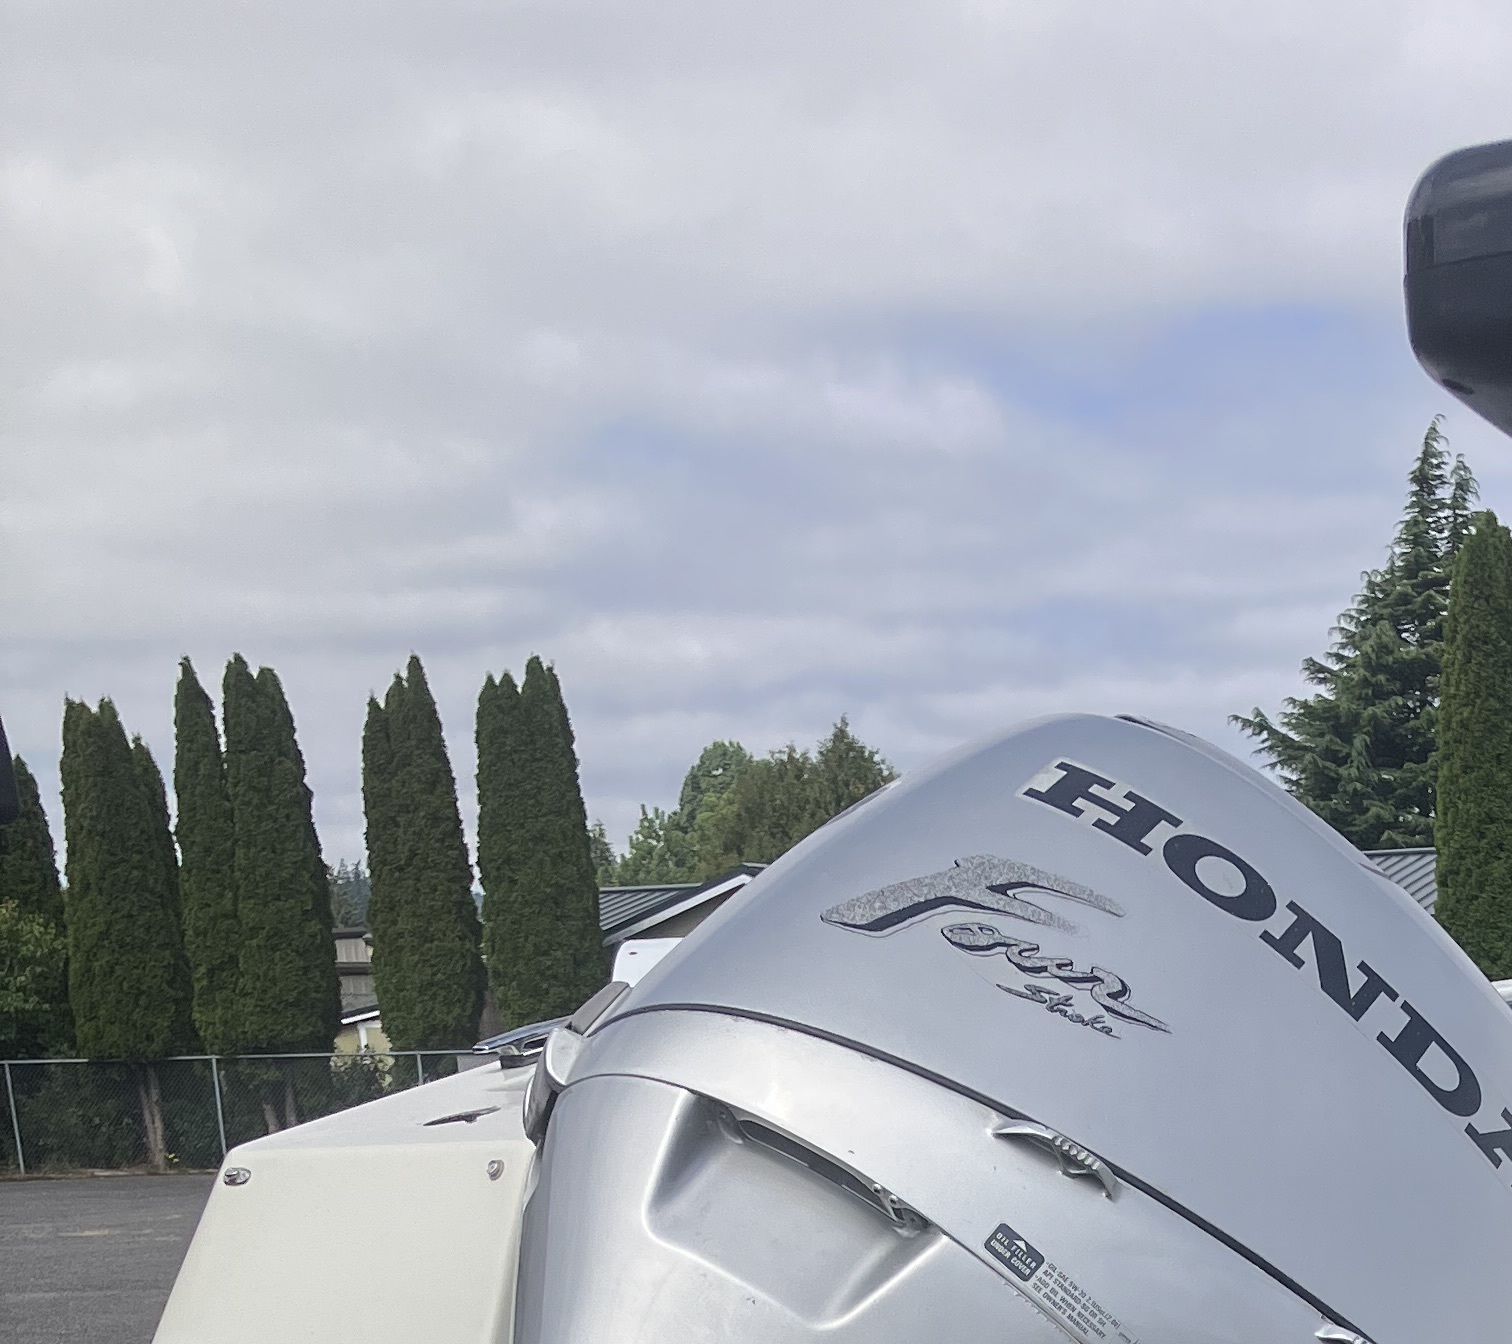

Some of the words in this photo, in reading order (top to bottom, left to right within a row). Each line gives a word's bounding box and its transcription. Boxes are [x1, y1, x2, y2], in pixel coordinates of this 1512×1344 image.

[996, 983, 1121, 1039] Stroke
[989, 1238, 1012, 1259] UNDER
[1009, 1255, 1032, 1276] COVER
[994, 1231, 1011, 1246] OIL
[1009, 1244, 1037, 1269] FILLER
[1030, 1281, 1043, 1294] SEE
[1040, 1291, 1068, 1316] OWNER'S
[1035, 1276, 1050, 1289] ADD
[1048, 1286, 1059, 1297] OIL
[1057, 1295, 1077, 1313] WHEN
[1041, 1268, 1054, 1281] API
[1087, 1309, 1098, 1320] OR
